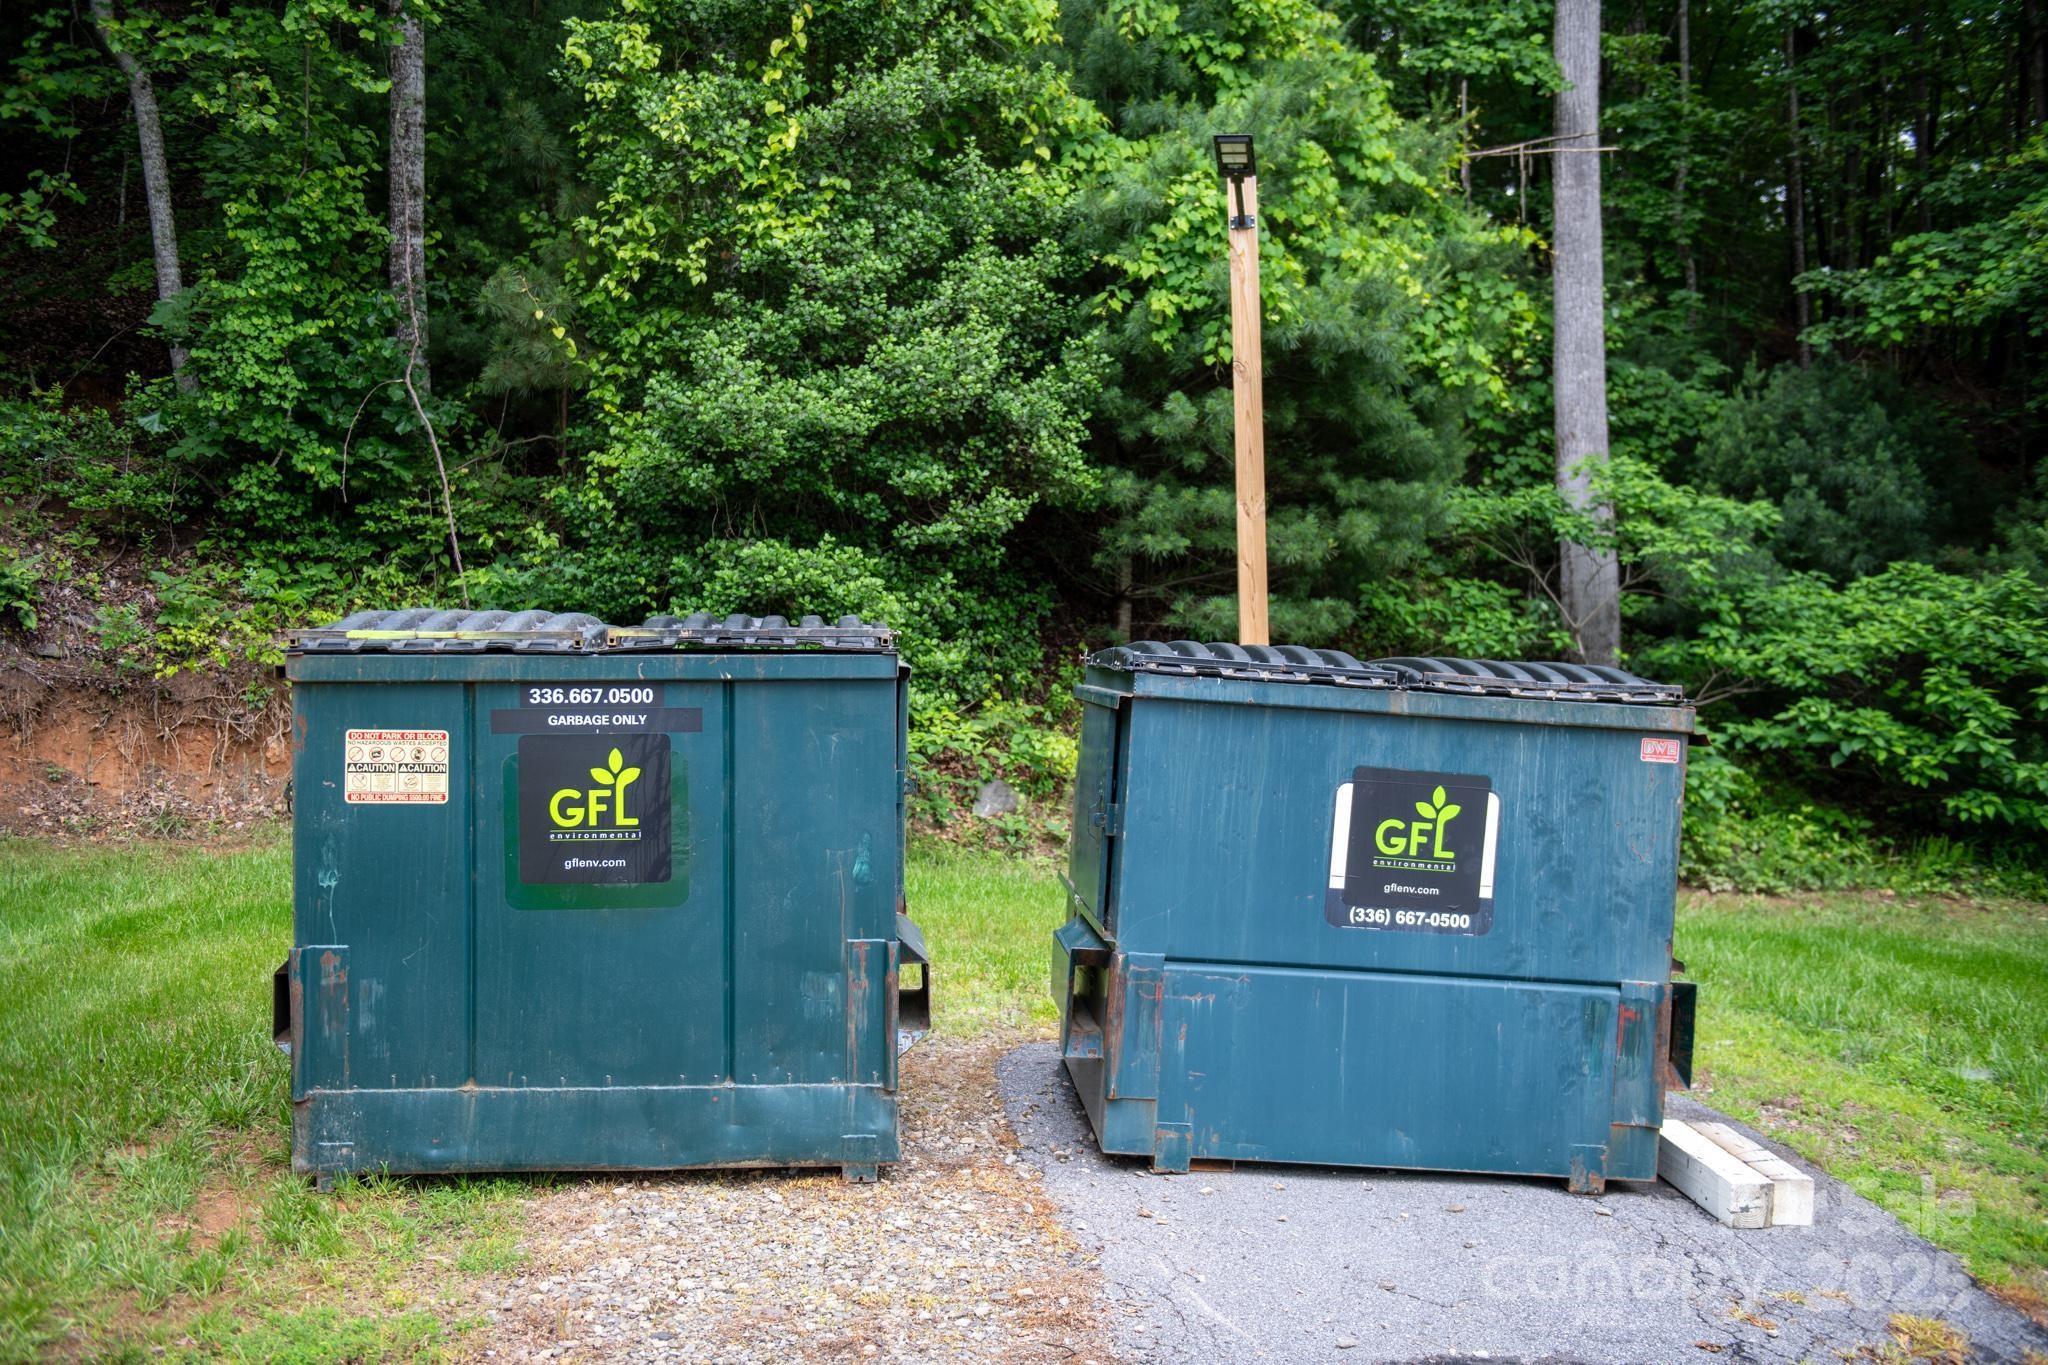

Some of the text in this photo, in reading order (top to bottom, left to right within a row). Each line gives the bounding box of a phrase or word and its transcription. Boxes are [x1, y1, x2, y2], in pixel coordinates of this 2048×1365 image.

[529, 688, 654, 704] 336.667.0500
[547, 714, 647, 726] GARBAGE ONLY
[351, 733, 443, 741] DO NOT PARK OR BLOCK
[356, 764, 395, 772] CAUTION
[407, 764, 446, 772] CAUTION
[549, 768, 641, 828] GFL
[550, 831, 642, 840] environmental
[1375, 806, 1457, 859] GFL
[564, 858, 627, 870] gflenv.com
[1373, 859, 1456, 871] environmental
[1383, 883, 1440, 895] gflenv.com
[1349, 906, 1470, 929] (336) 667-0500
